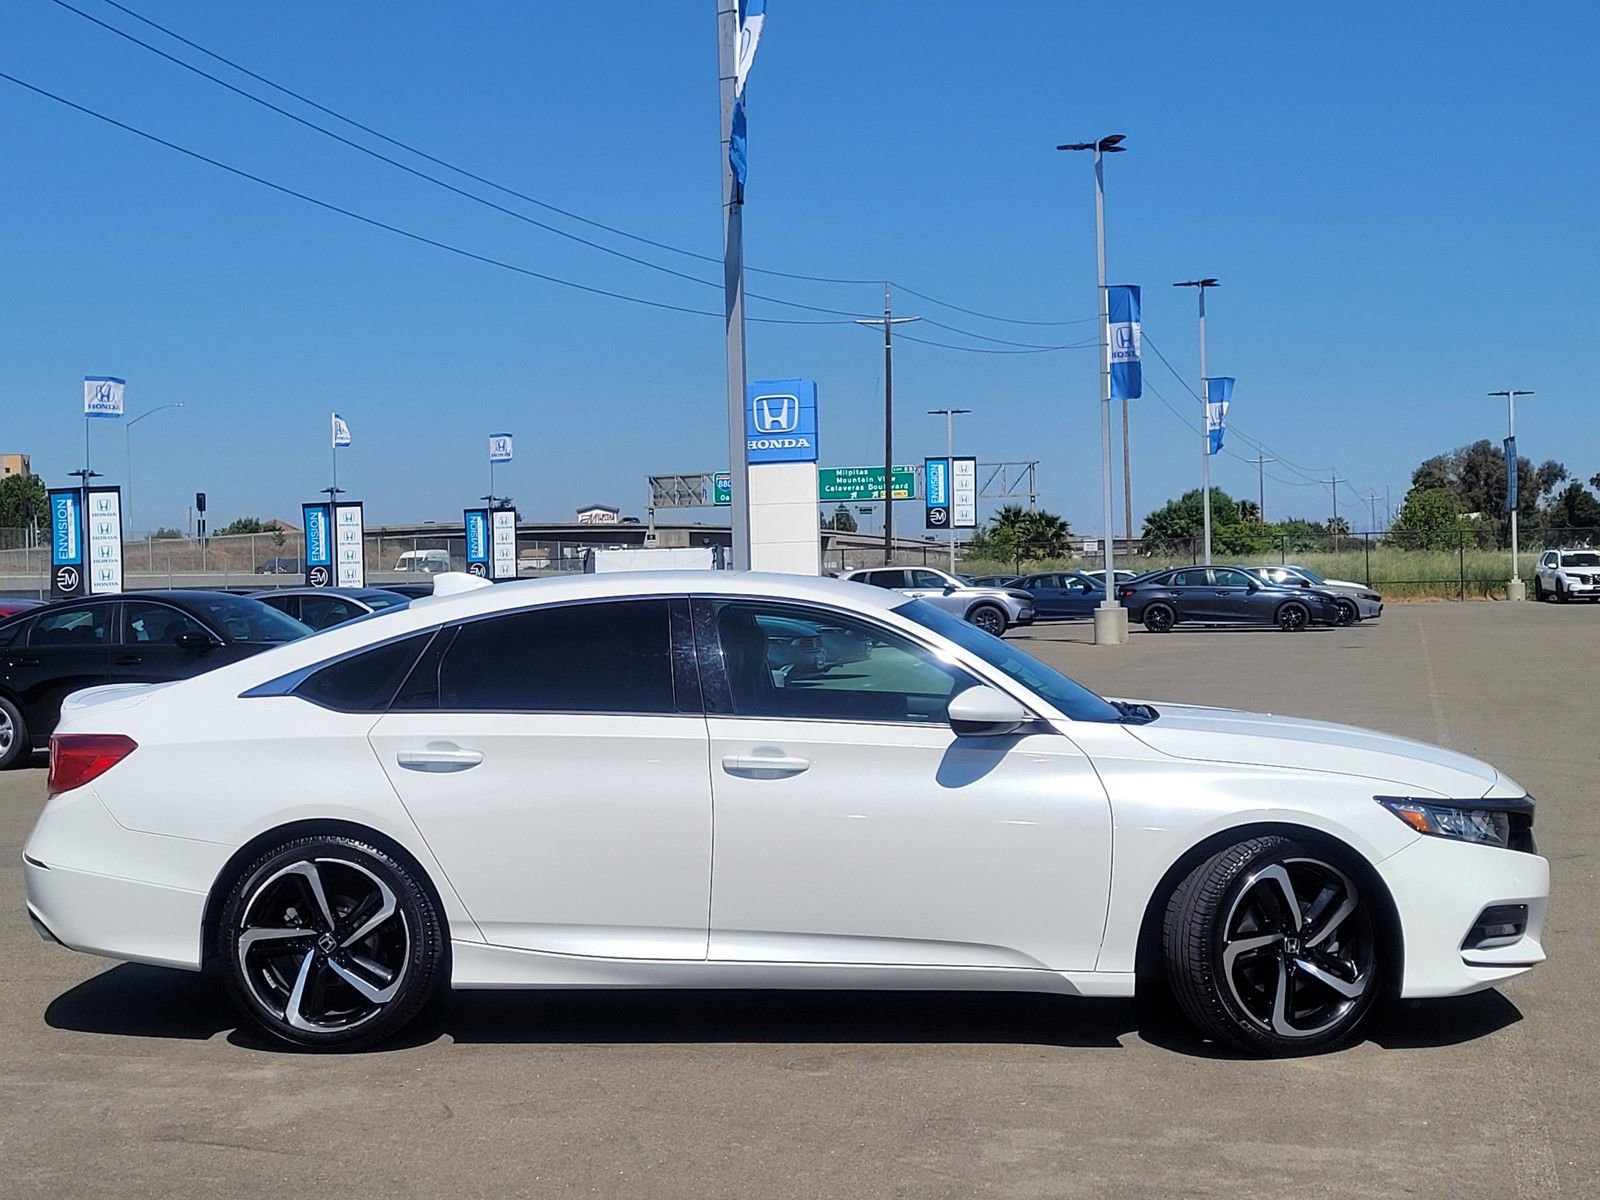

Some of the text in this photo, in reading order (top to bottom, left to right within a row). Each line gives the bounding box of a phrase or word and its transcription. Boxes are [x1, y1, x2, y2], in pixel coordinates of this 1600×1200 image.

[747, 438, 810, 450] HONDA
[825, 484, 864, 492] Calaveras
[930, 464, 938, 503] ENVISION
[57, 499, 68, 559] ENVISION
[310, 512, 319, 561] ENVISION
[470, 516, 478, 558] ENVISION
